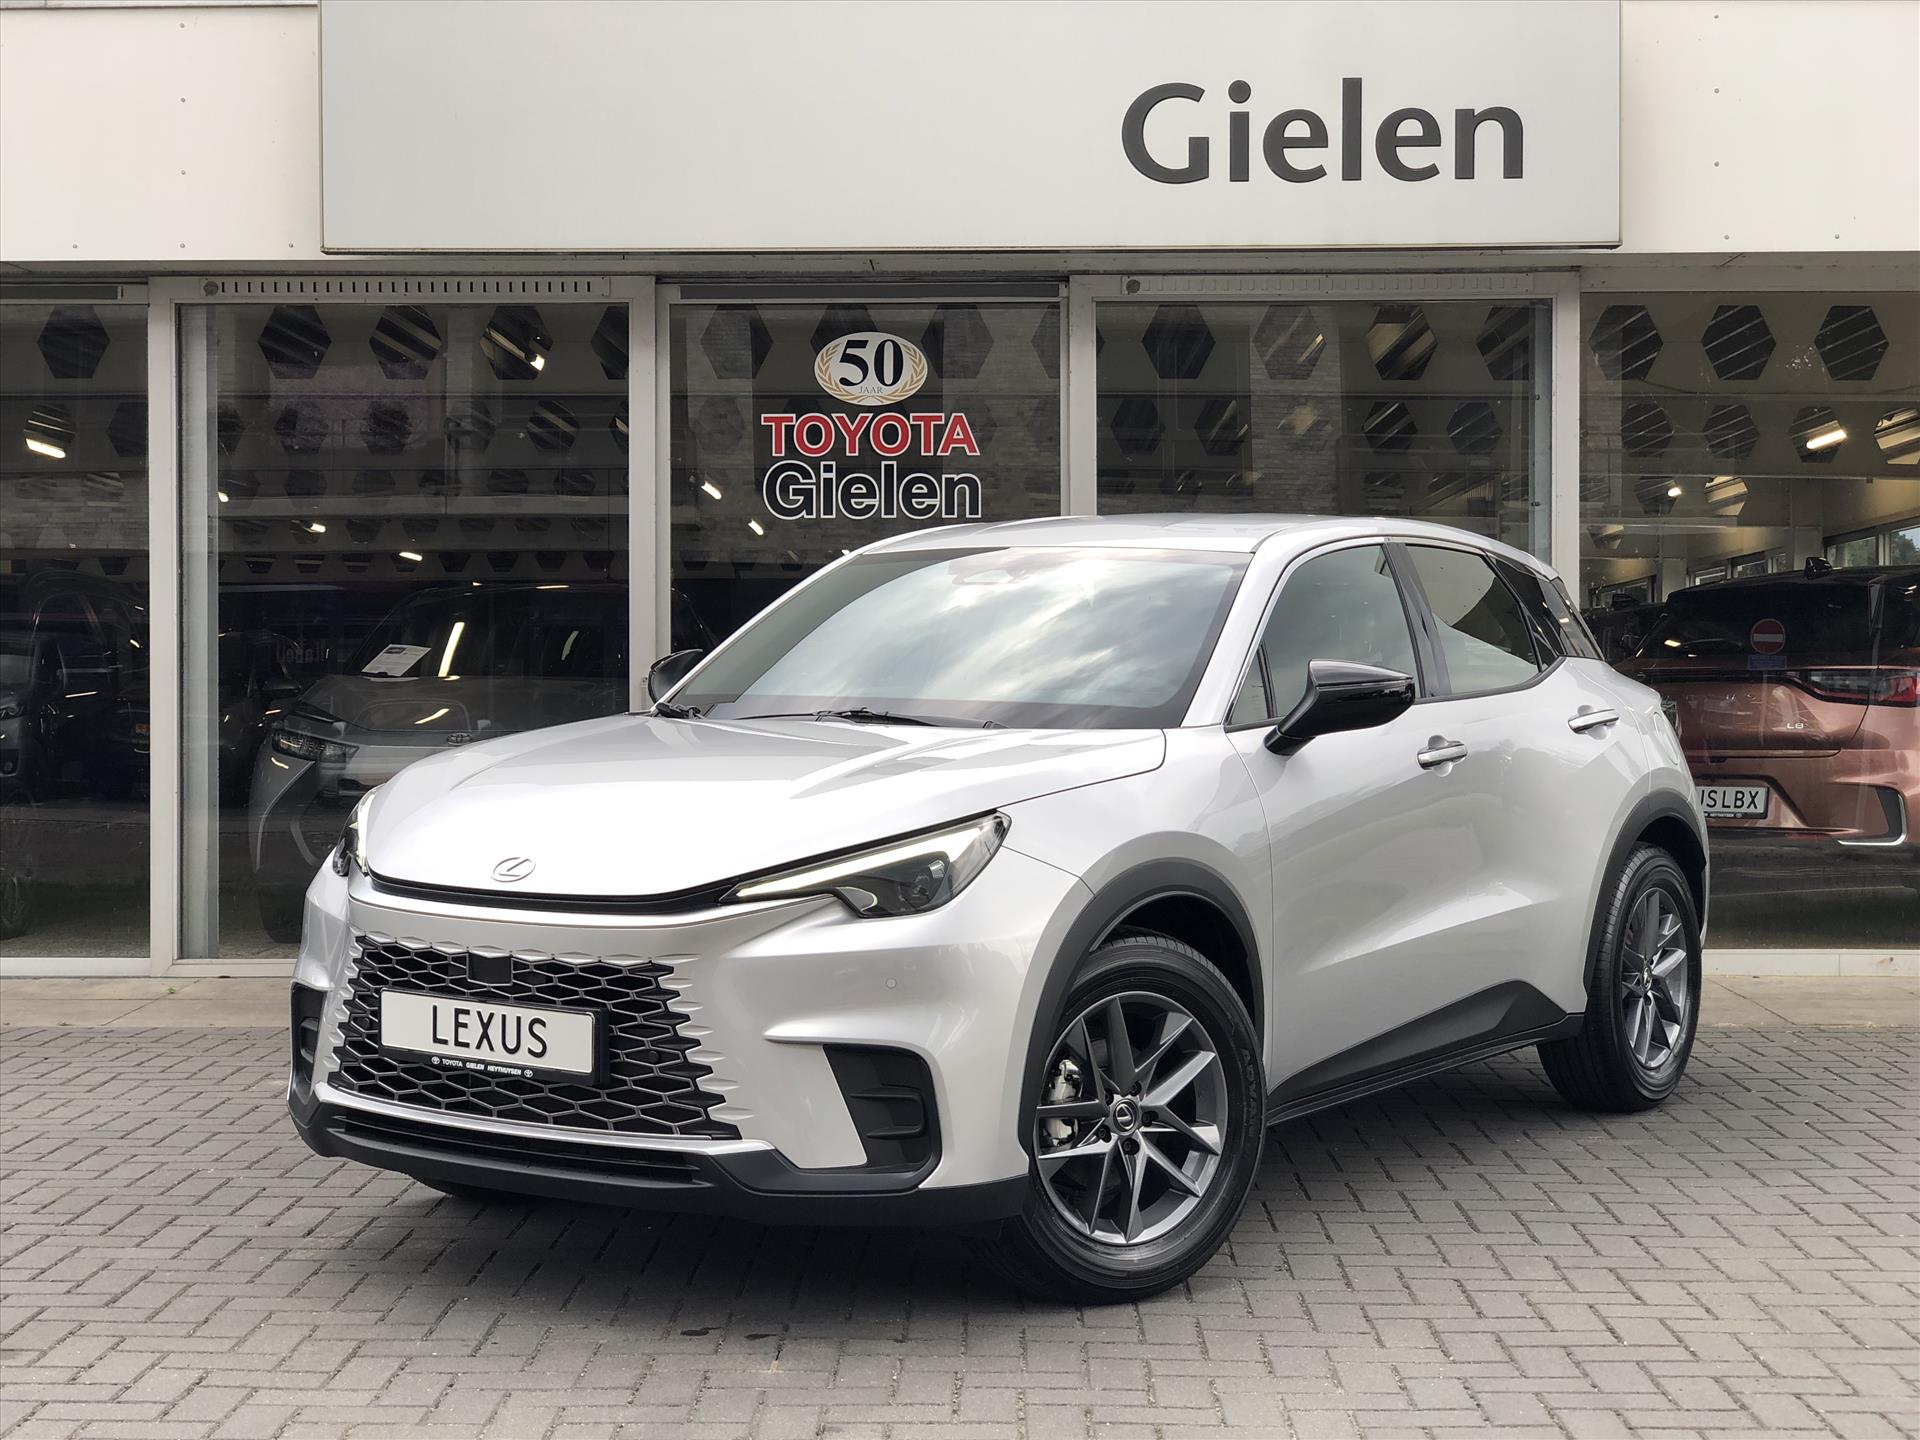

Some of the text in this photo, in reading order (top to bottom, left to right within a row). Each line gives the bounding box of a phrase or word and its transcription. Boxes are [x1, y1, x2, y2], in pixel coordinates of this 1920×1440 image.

[1121, 77, 1524, 185] Gielen
[838, 338, 904, 387] 50
[858, 386, 884, 394] JAAR
[761, 412, 981, 457] TOYOTA
[763, 460, 982, 520] Gielen
[432, 1004, 548, 1058] LEXUS
[441, 1058, 522, 1076] TOYOTA GIELEN HEYTHUYSEN
